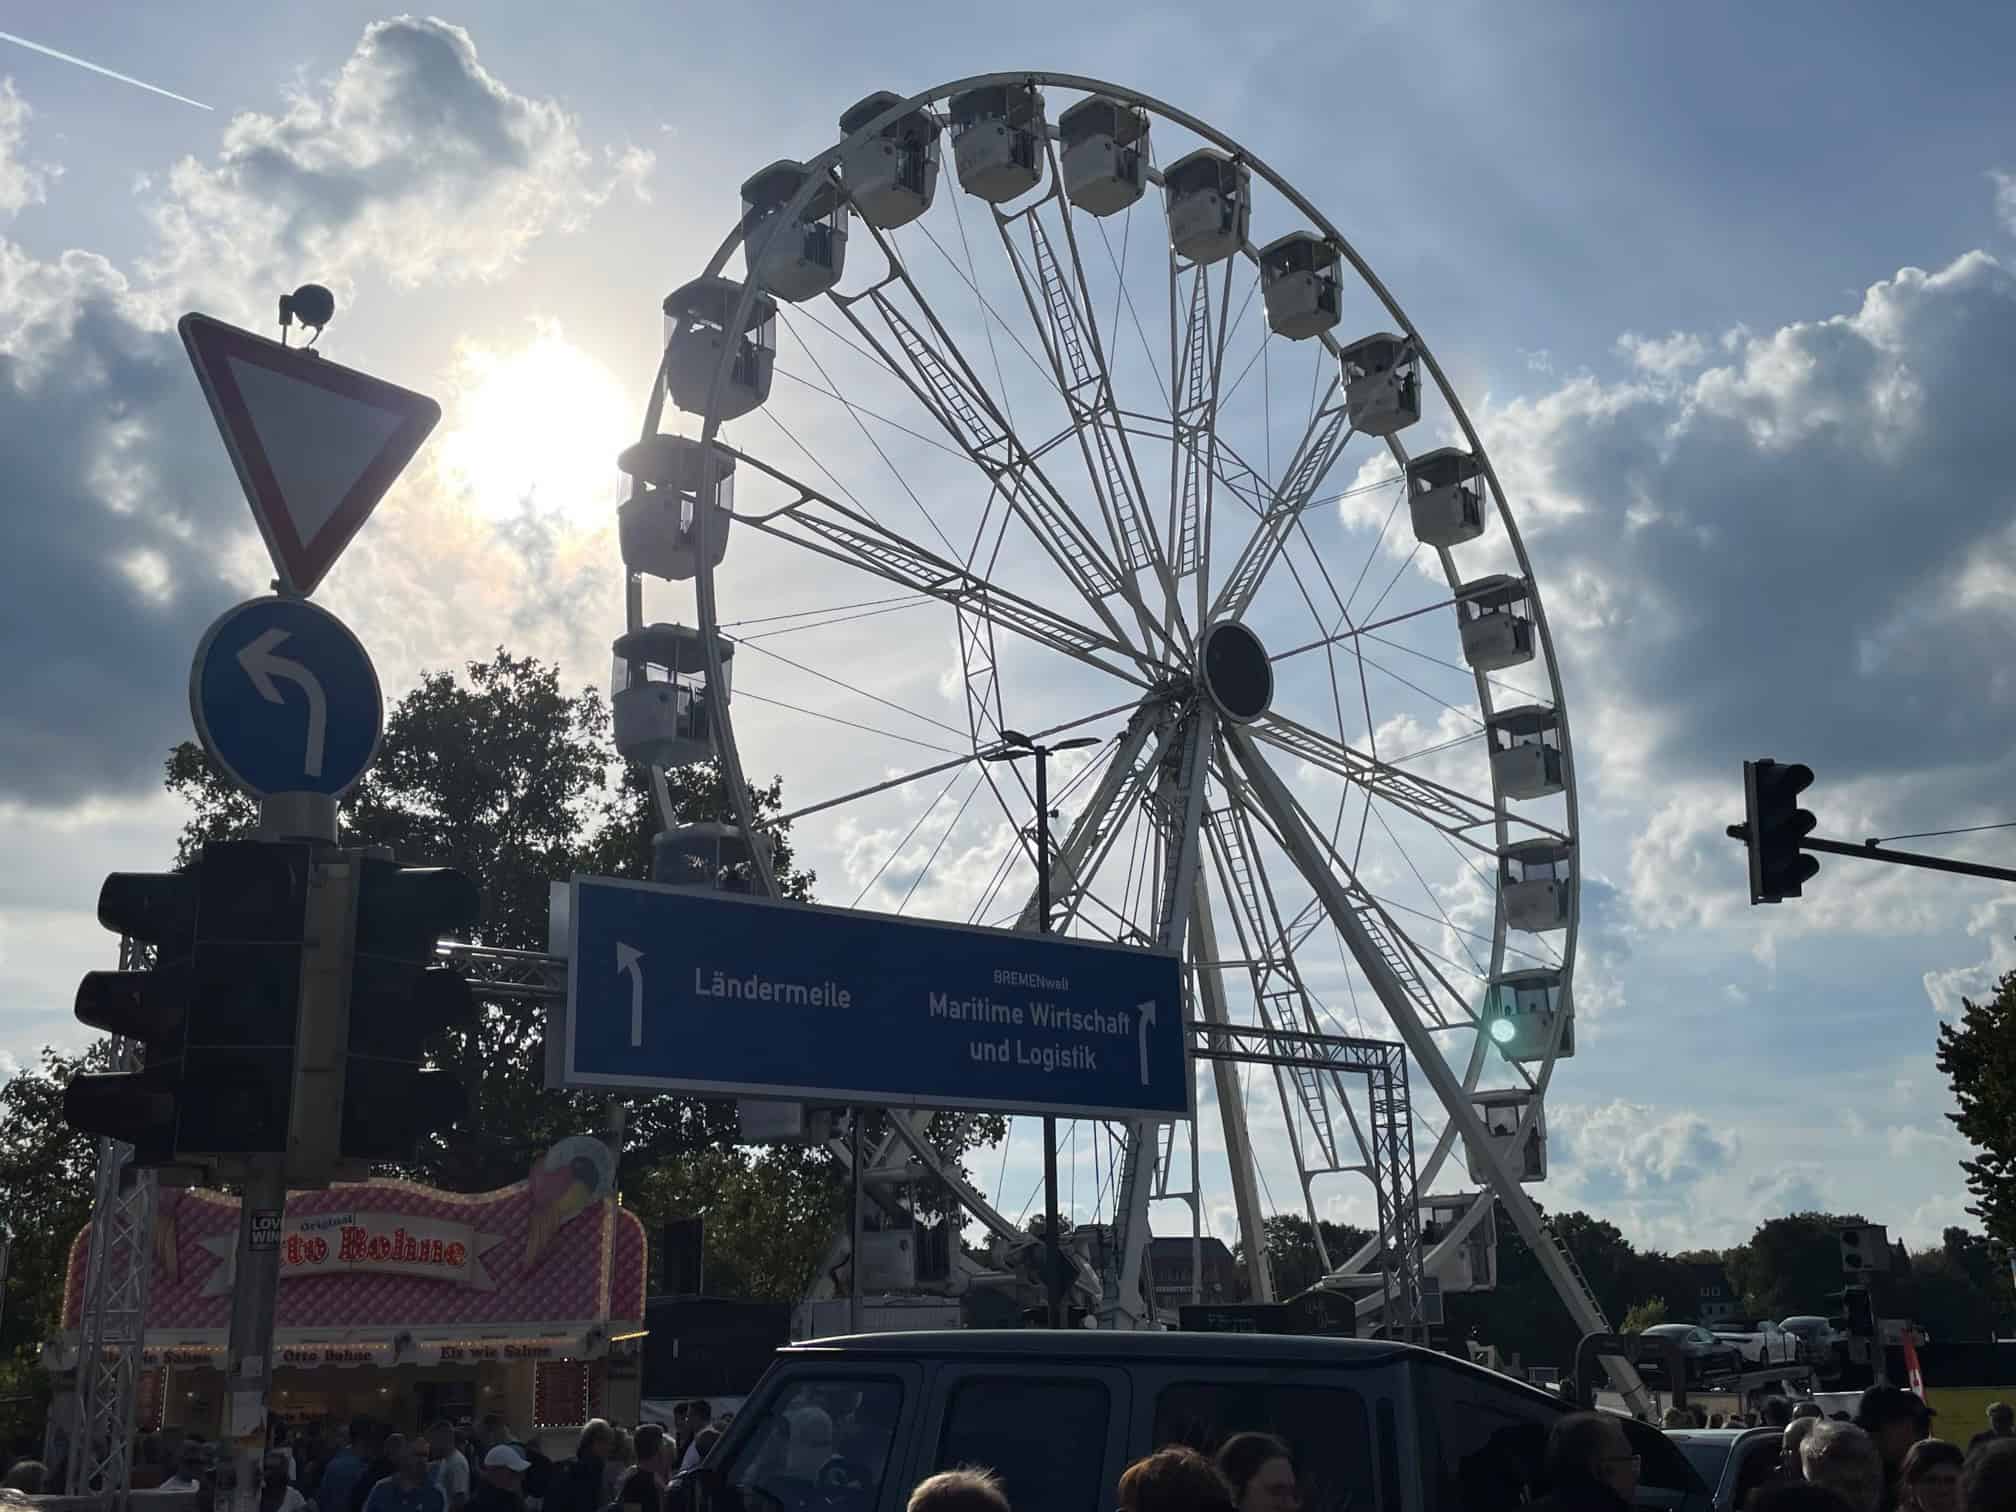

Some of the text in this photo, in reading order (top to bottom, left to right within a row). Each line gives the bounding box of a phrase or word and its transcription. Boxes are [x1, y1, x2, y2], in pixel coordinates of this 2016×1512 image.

[694, 966, 852, 1009] Ländermeile
[928, 991, 1131, 1036] Maritime Wirtschaft
[969, 1038, 1098, 1073] und Logistik
[251, 1216, 281, 1231] LOV
[339, 1225, 466, 1267] Bohne
